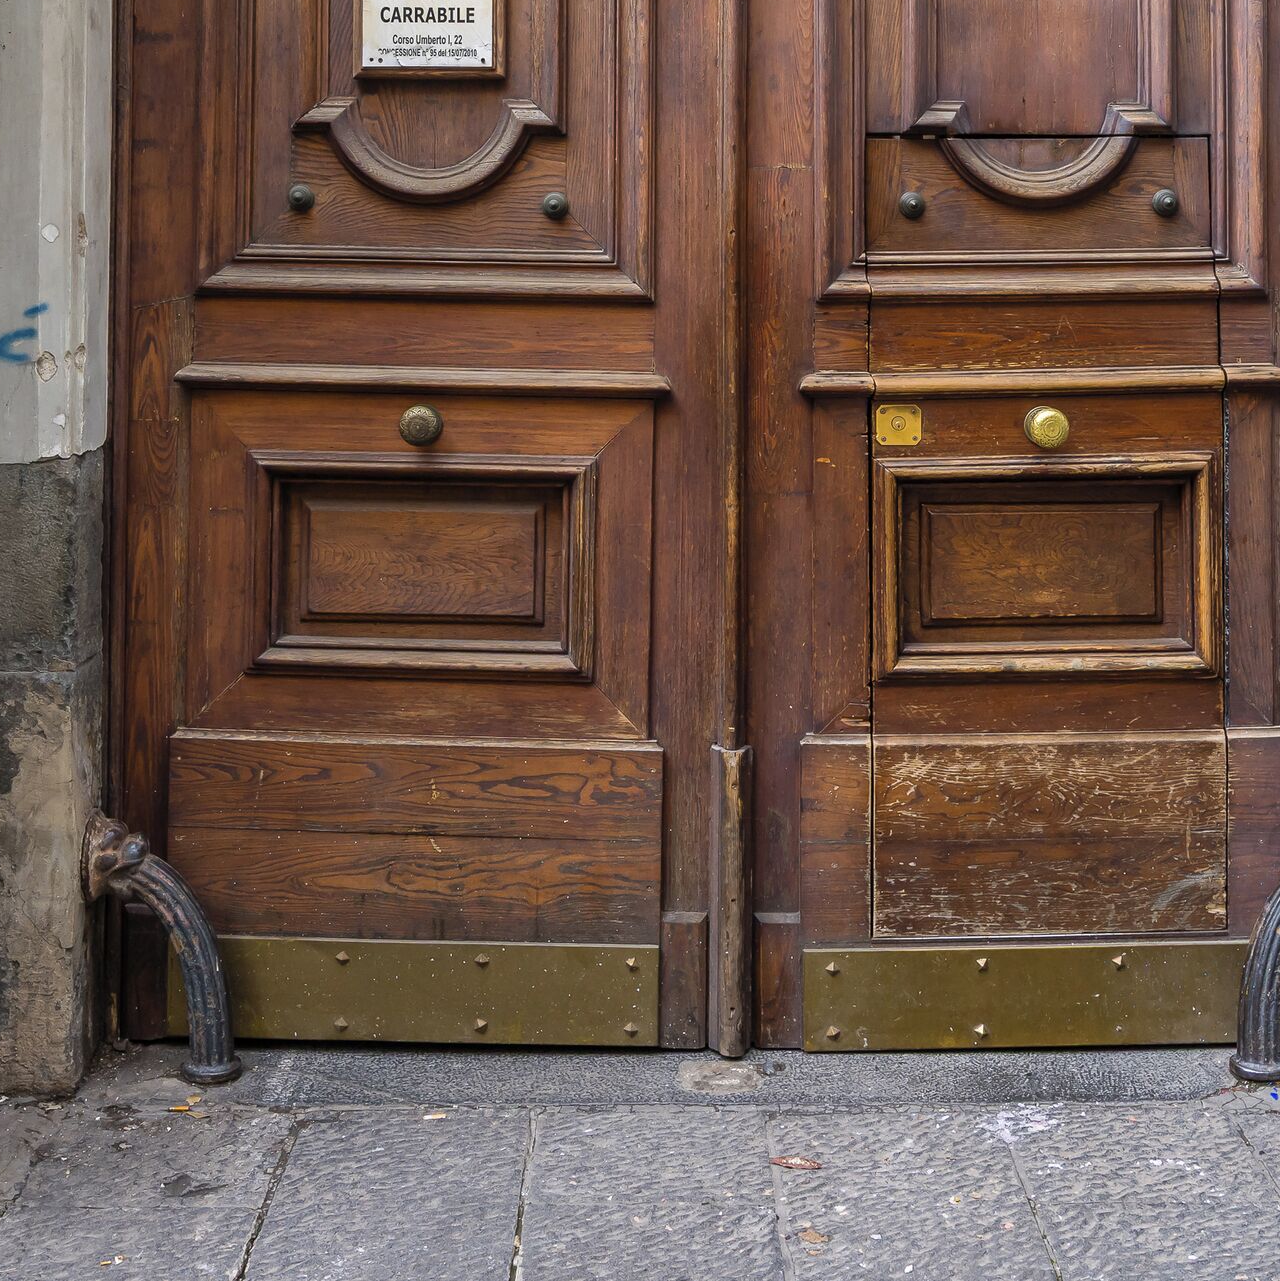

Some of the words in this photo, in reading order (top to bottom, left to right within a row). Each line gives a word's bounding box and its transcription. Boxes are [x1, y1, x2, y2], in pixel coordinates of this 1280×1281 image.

[380, 6, 476, 24] CARRABILE
[392, 34, 415, 46] Corso
[415, 34, 447, 46] Umberto
[454, 34, 463, 46] 22
[430, 48, 438, 58] 95
[438, 48, 447, 58] del
